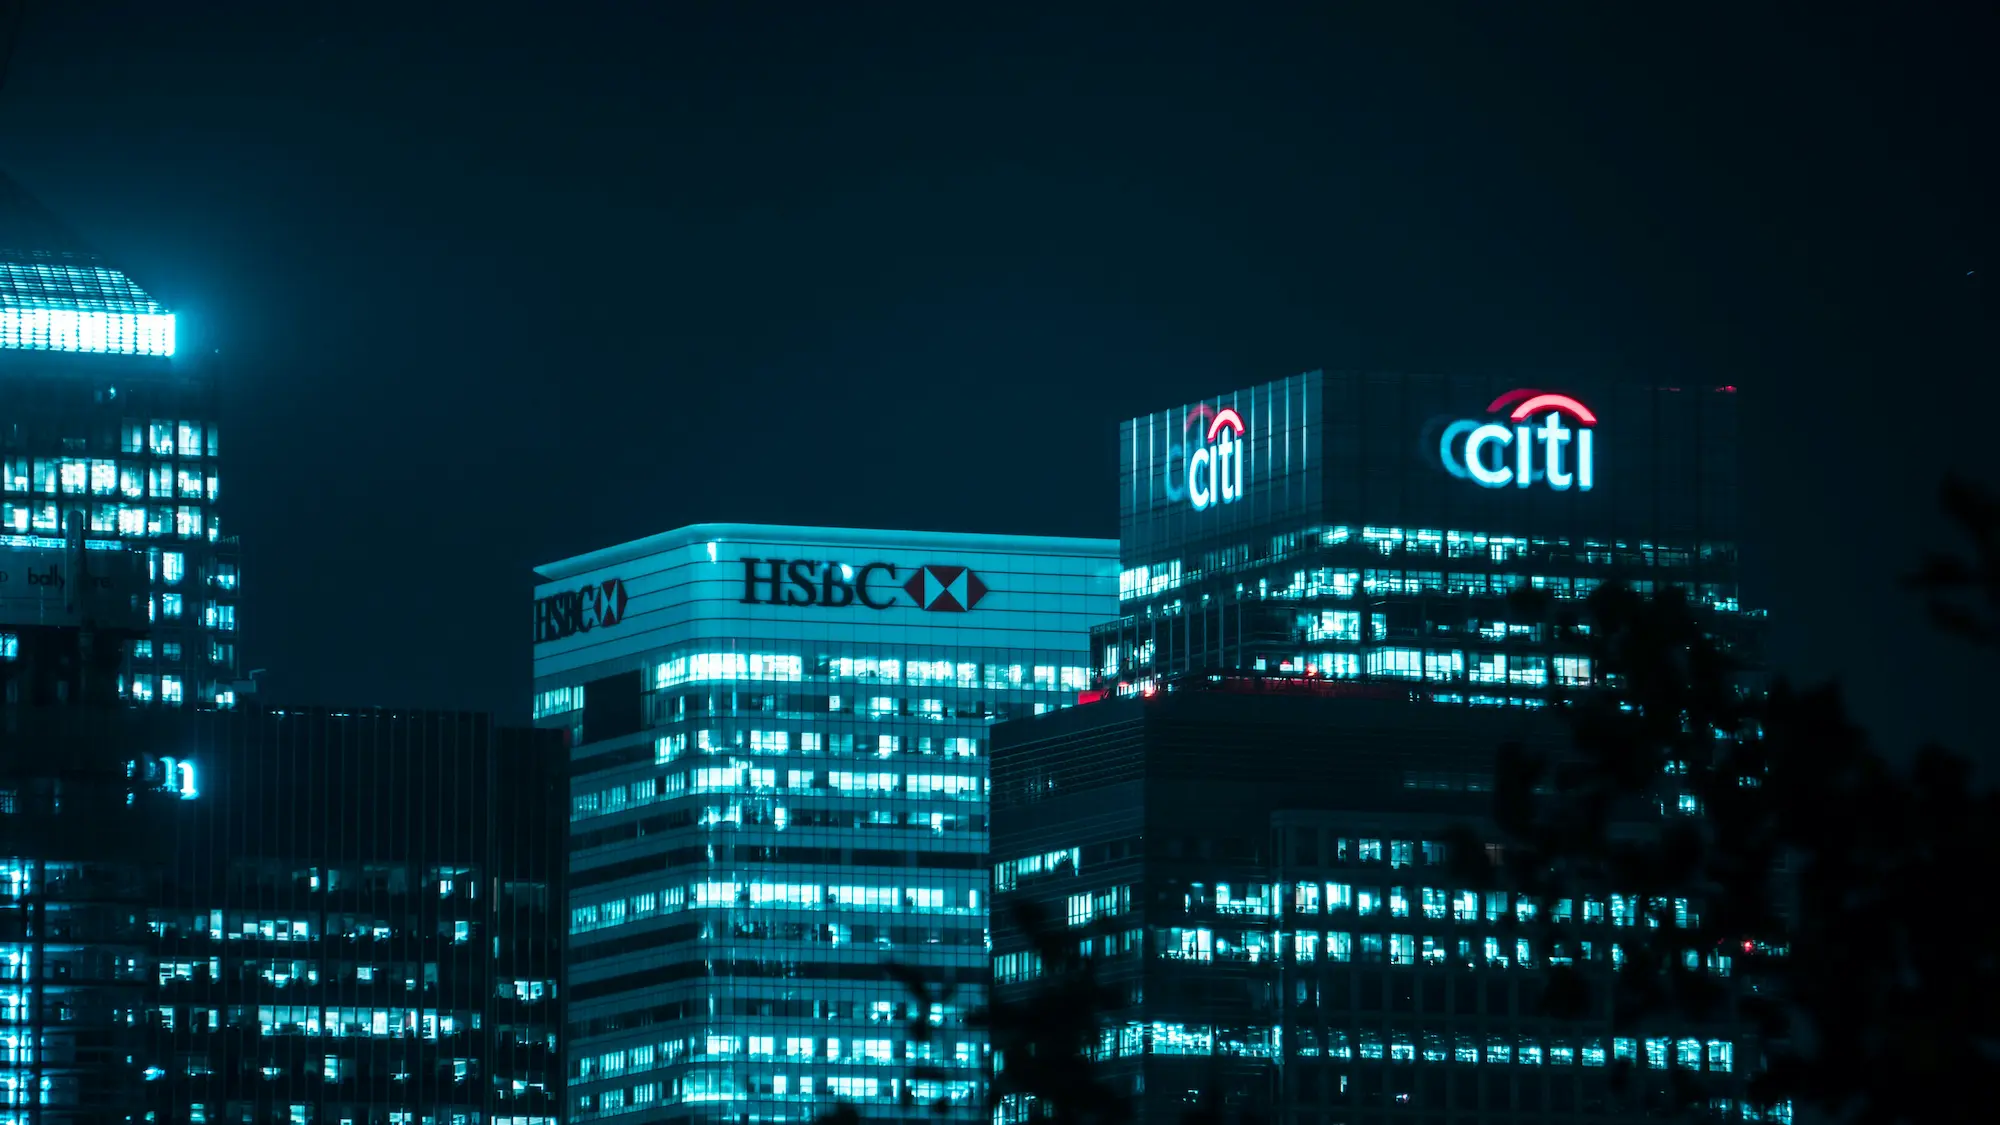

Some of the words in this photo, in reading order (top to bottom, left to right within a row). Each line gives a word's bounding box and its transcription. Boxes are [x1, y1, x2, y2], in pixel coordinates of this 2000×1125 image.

[1189, 425, 1244, 512] citi
[1465, 410, 1594, 492] citi
[533, 585, 595, 643] HSBC
[739, 557, 897, 610] HSBC
